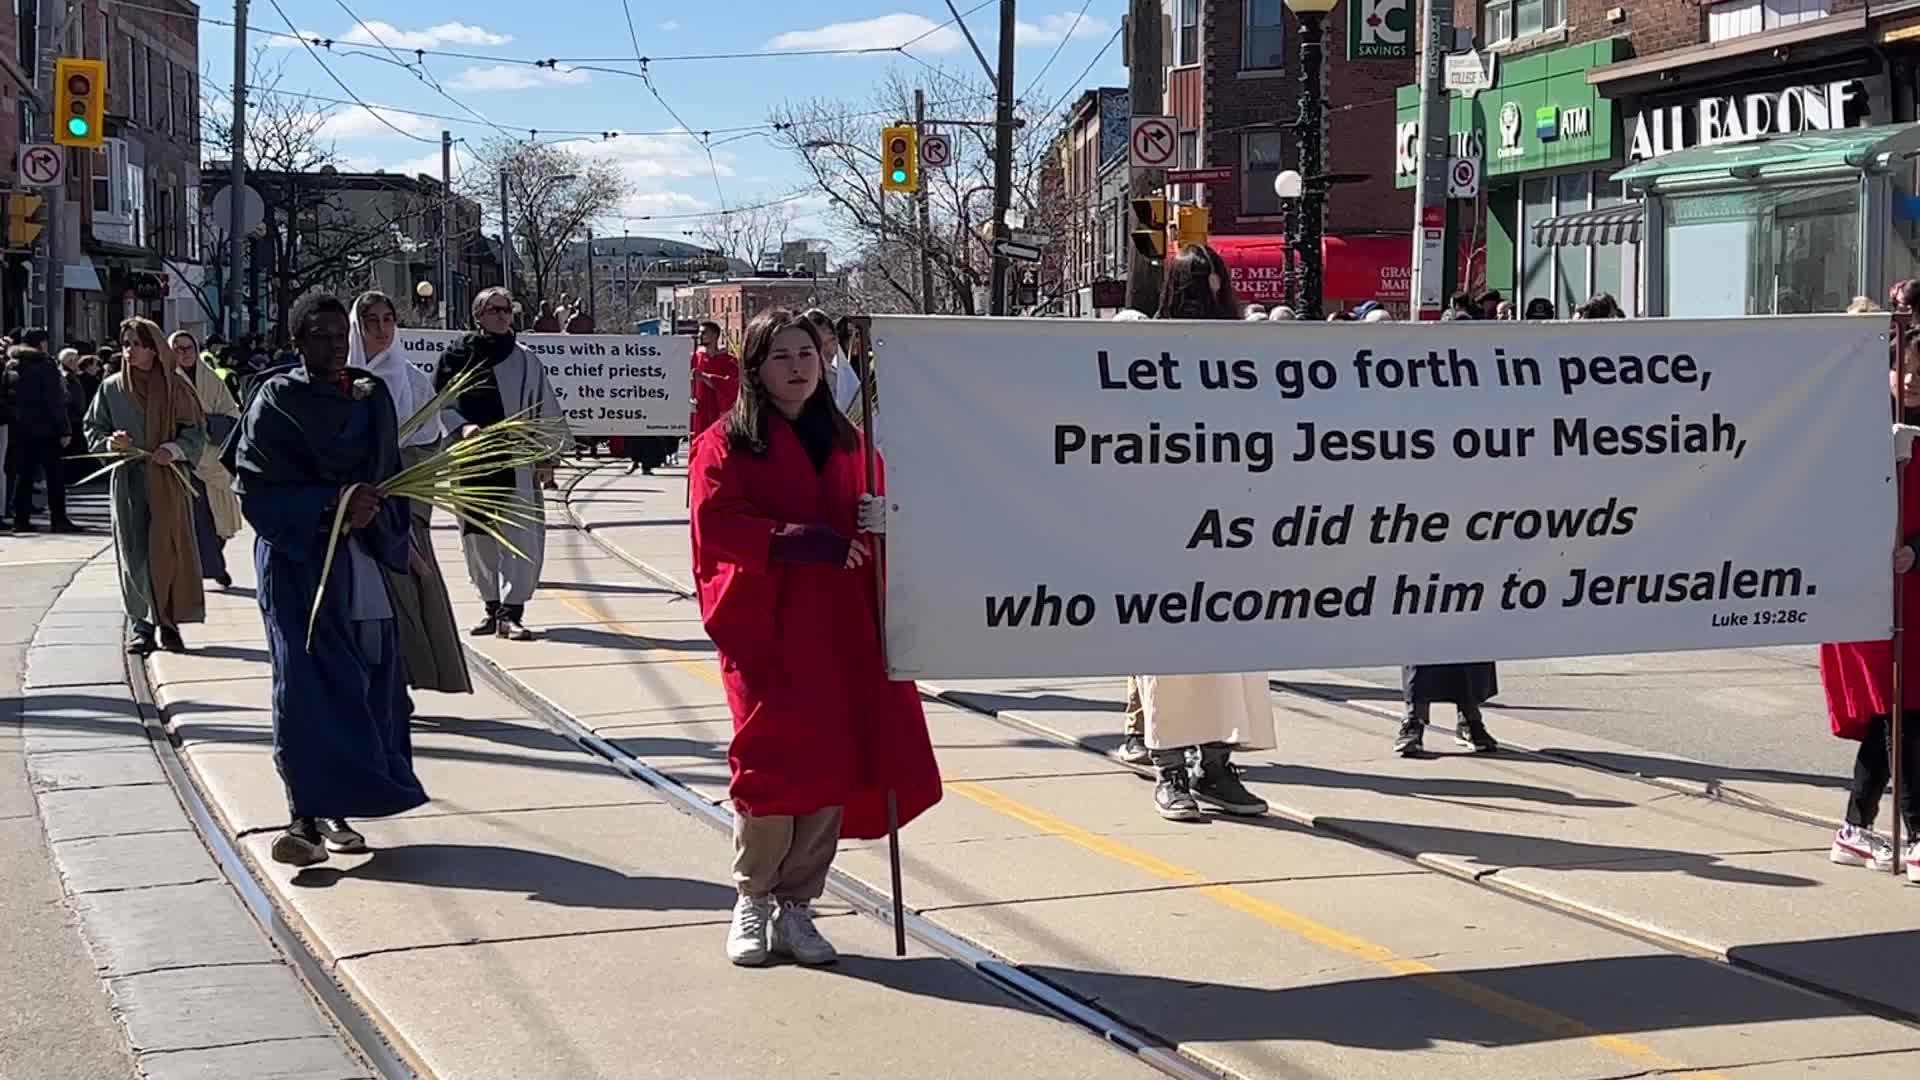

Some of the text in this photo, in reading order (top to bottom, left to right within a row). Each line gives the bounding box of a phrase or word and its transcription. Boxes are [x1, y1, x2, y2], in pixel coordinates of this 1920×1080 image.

[1359, 46, 1407, 56] SAVINGS
[1560, 107, 1588, 136] ATM
[1629, 80, 1858, 160] ALL BAR ONE
[401, 338, 445, 352] udas
[520, 340, 662, 357] esus with a kiss.
[563, 361, 604, 377] chief
[608, 362, 667, 379] priests,
[1097, 347, 1712, 400] Let us go forth in peace,
[577, 384, 604, 399] the
[609, 384, 670, 401] scribes,
[597, 406, 647, 420] Jesus.
[1054, 412, 1748, 473] Praising Jesus our Messiah,
[1185, 496, 1639, 550] As did the crowds
[985, 560, 1817, 628] who welcomed him to Jerusalem.
[1711, 609, 1809, 628] Luke 19:28c
